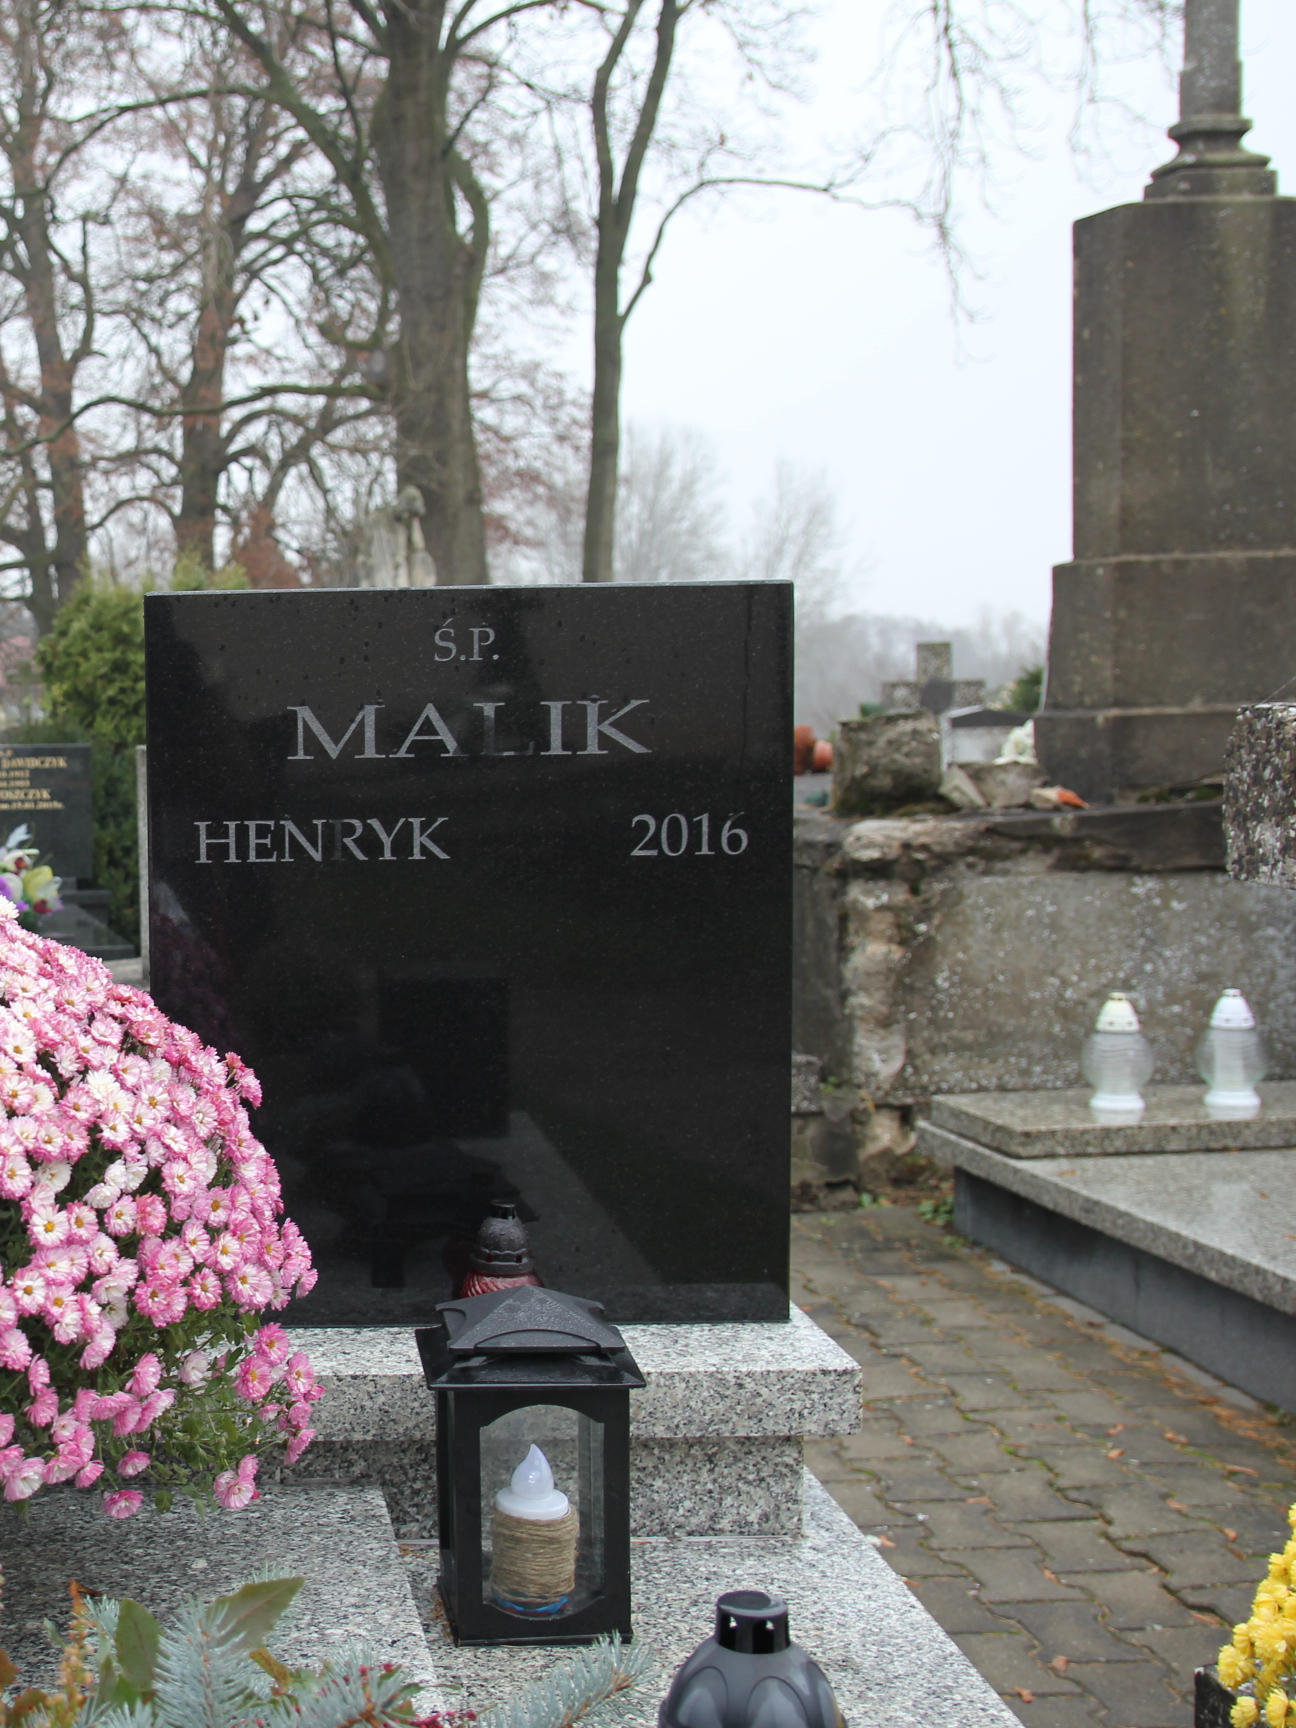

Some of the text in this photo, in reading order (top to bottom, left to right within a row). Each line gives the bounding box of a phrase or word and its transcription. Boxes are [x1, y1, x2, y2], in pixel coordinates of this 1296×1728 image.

[433, 618, 500, 662] Ś.P.
[287, 699, 652, 760] MALIK
[193, 811, 750, 863] HENRYK 2016
